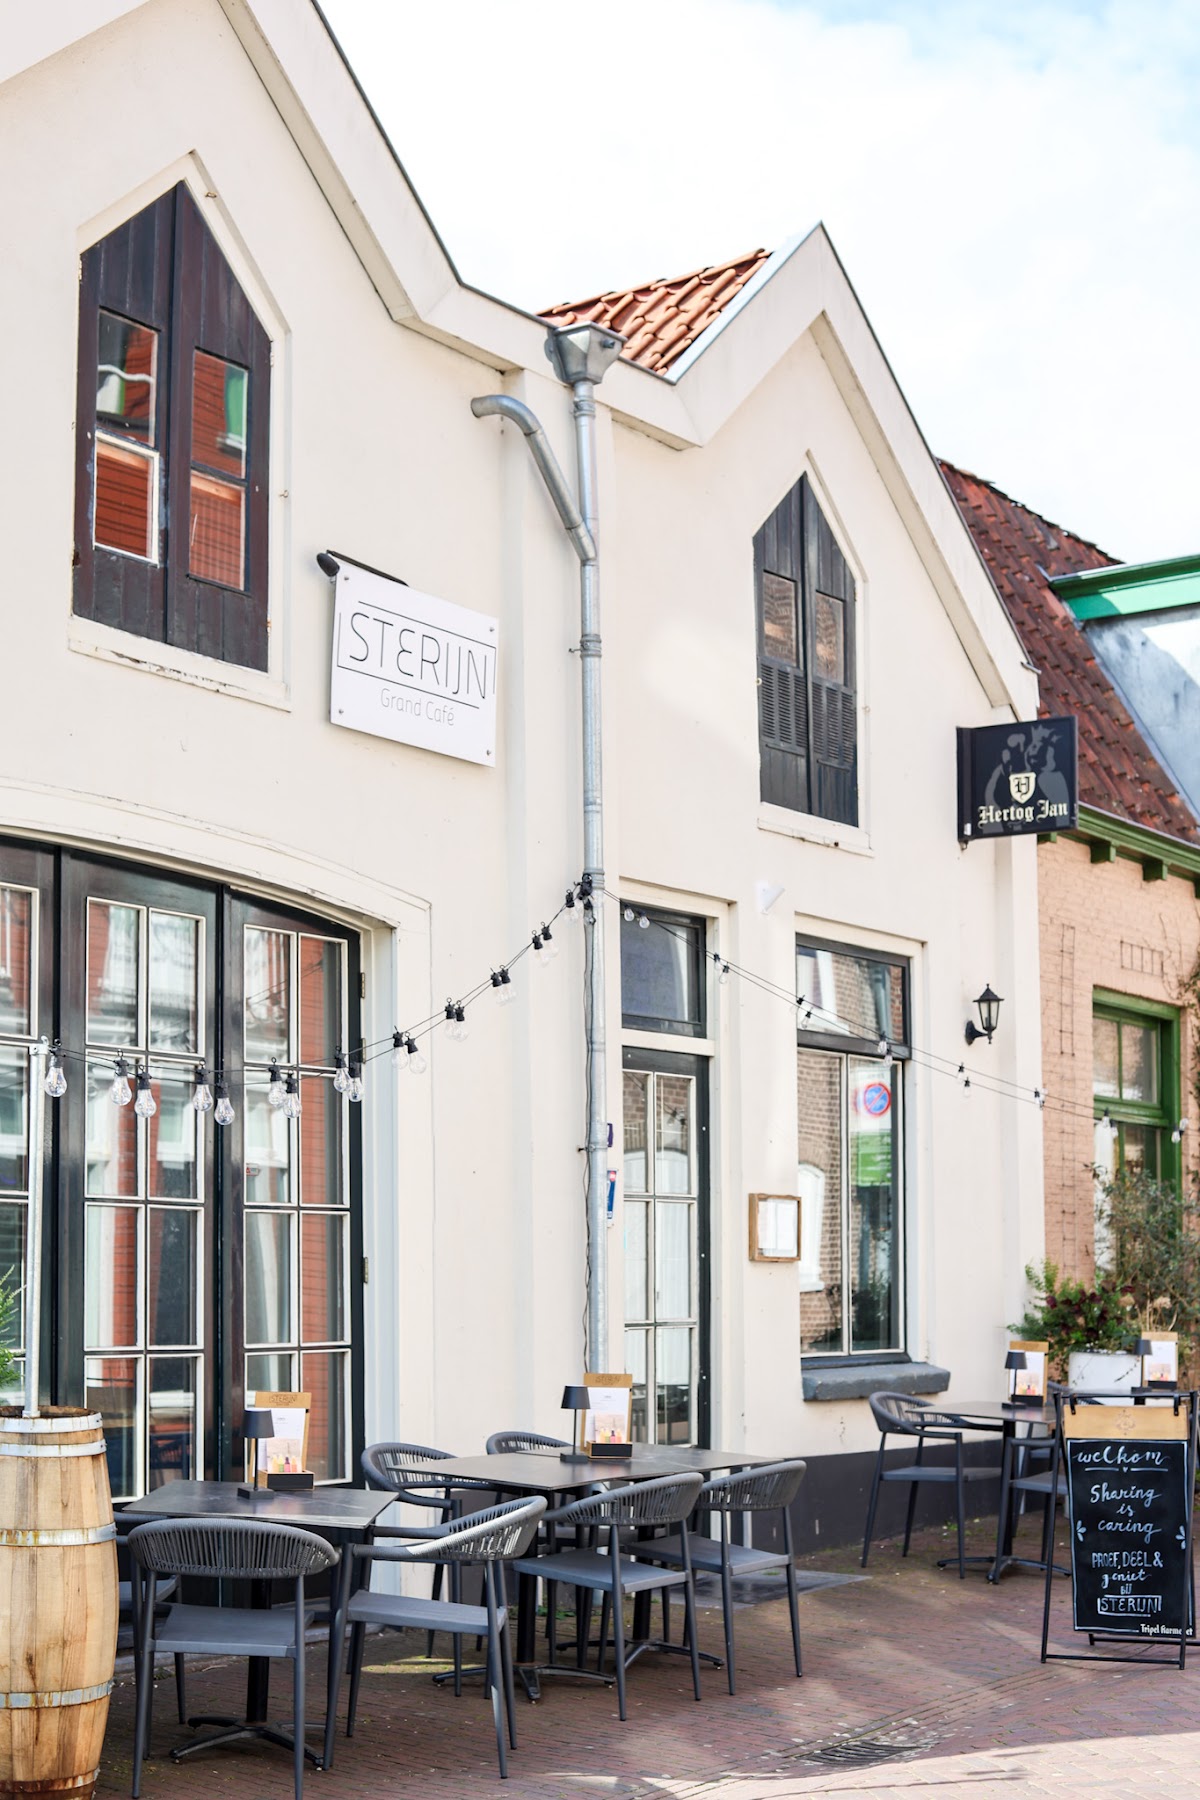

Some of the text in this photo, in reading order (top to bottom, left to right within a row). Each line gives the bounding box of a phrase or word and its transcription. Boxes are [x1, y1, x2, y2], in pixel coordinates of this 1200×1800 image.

[350, 612, 487, 699] STERIJN
[380, 688, 455, 726] Grand Café
[977, 800, 1068, 829] Hertog Jan
[1072, 1446, 1171, 1465] welkom
[1090, 1482, 1162, 1507] Sharing
[1116, 1503, 1134, 1517] is
[1097, 1520, 1162, 1544] caring
[1091, 1551, 1163, 1569] PROEF, DEEL &
[1101, 1569, 1152, 1589] geniet
[1100, 1598, 1158, 1613] STERIJN
[1140, 1623, 1193, 1636] Tripel Karmeet
